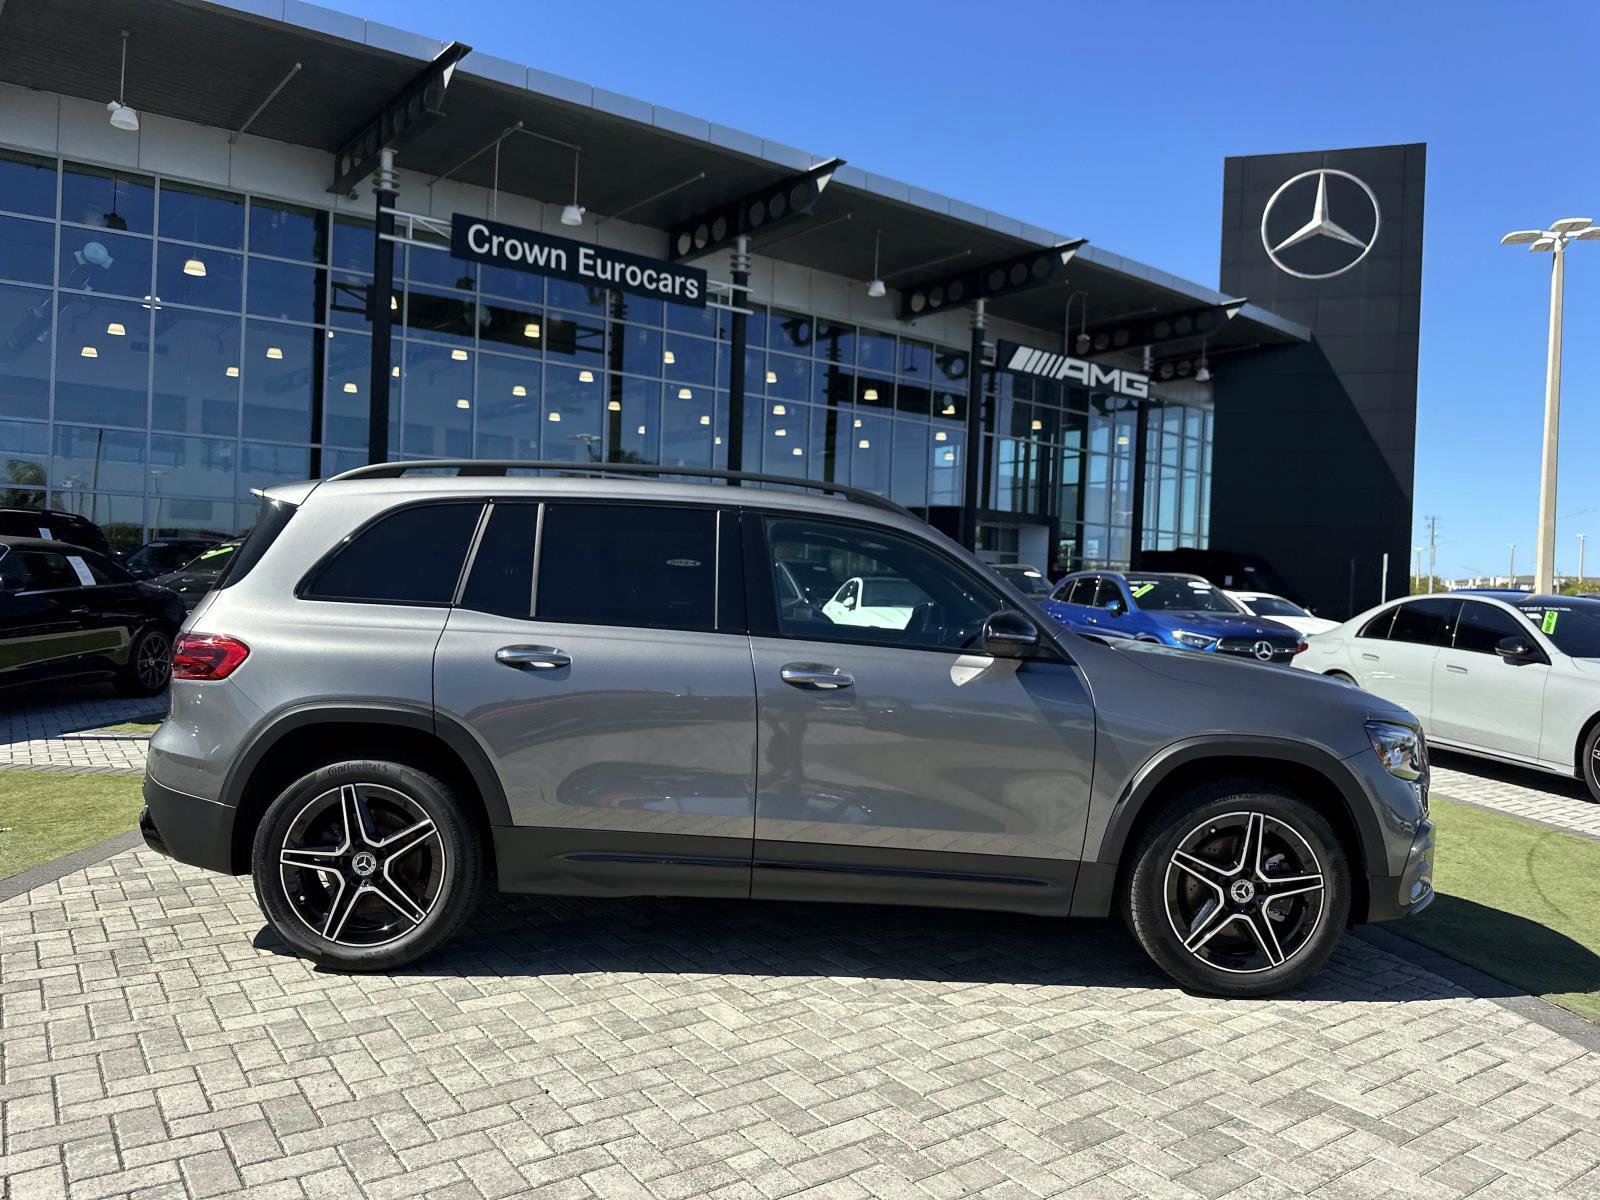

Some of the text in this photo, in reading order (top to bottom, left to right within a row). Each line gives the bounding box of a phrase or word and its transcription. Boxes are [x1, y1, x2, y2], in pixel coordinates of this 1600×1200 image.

[467, 224, 699, 299] Crown Eurocars
[1055, 357, 1149, 399] AMG
[327, 762, 381, 776] Continental
